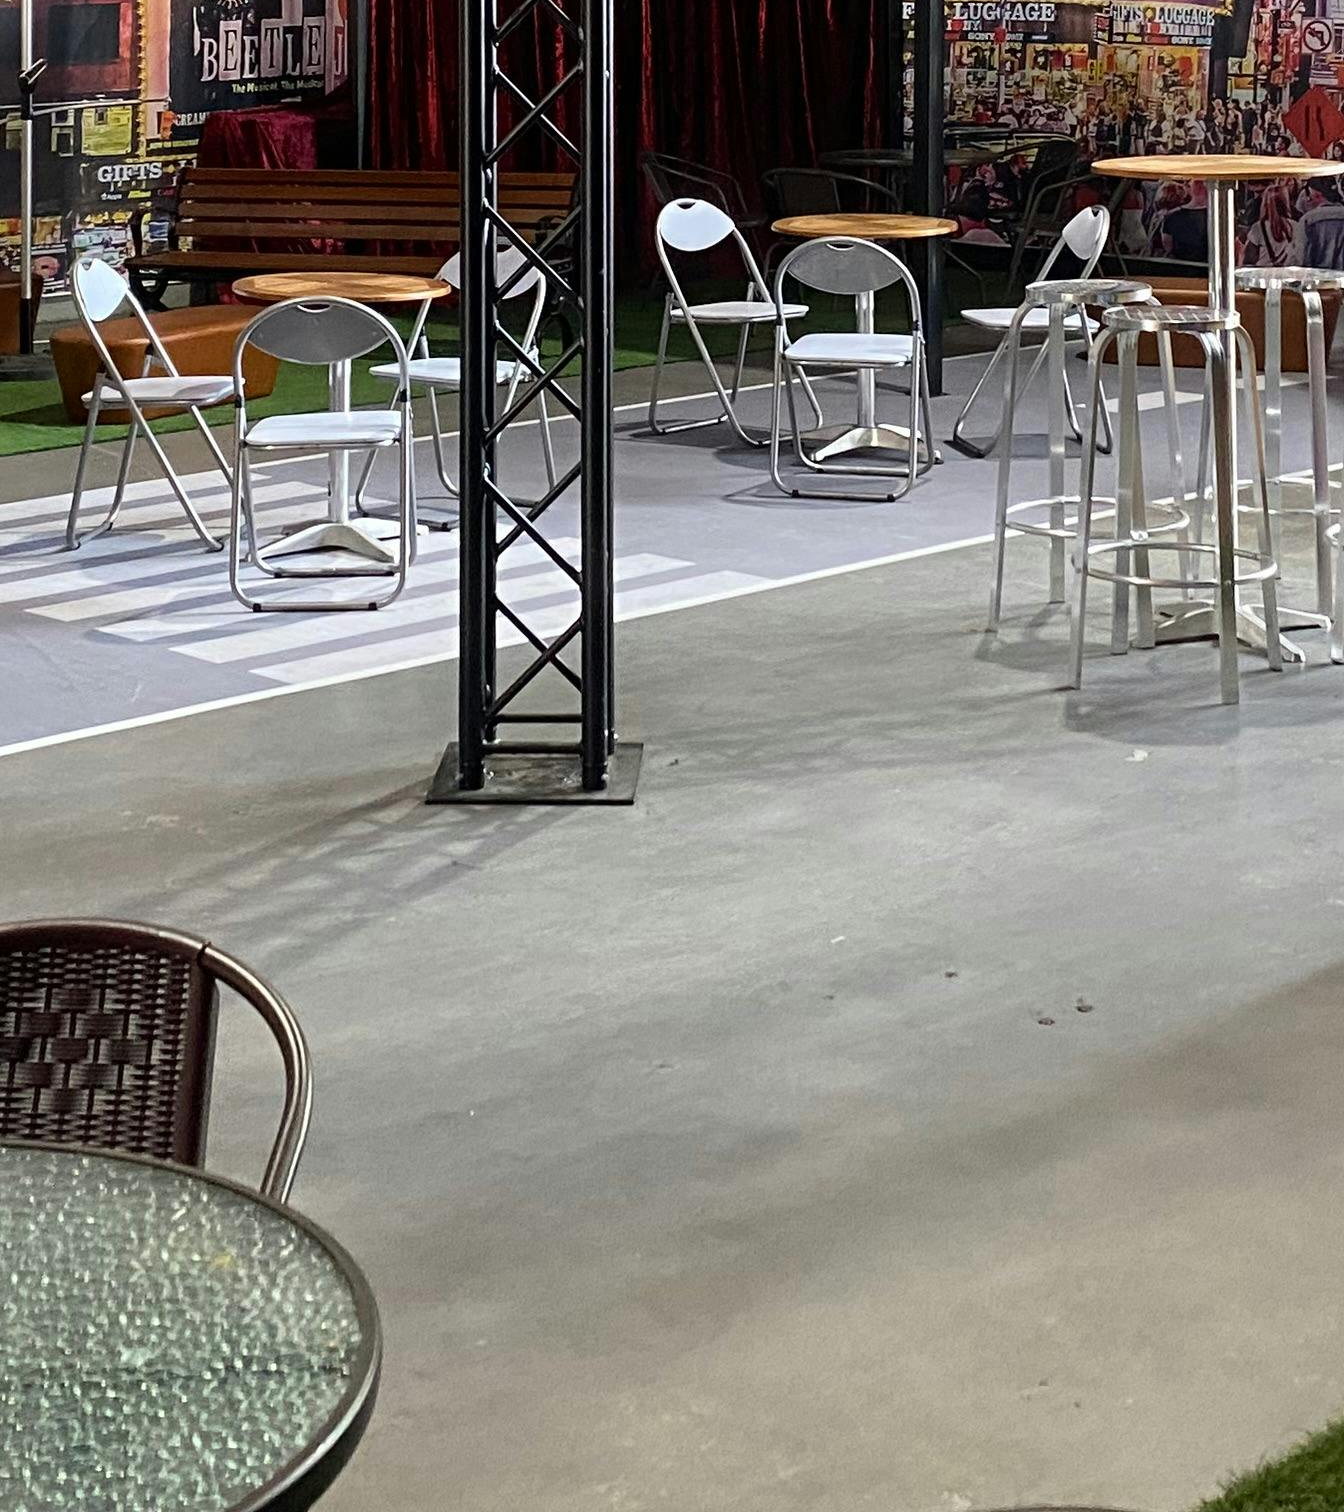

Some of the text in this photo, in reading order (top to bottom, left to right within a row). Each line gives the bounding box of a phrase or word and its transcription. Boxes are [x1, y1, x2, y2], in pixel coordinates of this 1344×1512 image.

[953, 3, 1056, 21] LUGGAGE
[1154, 7, 1215, 26] LUGGAGE
[97, 162, 163, 183] GIFTS
